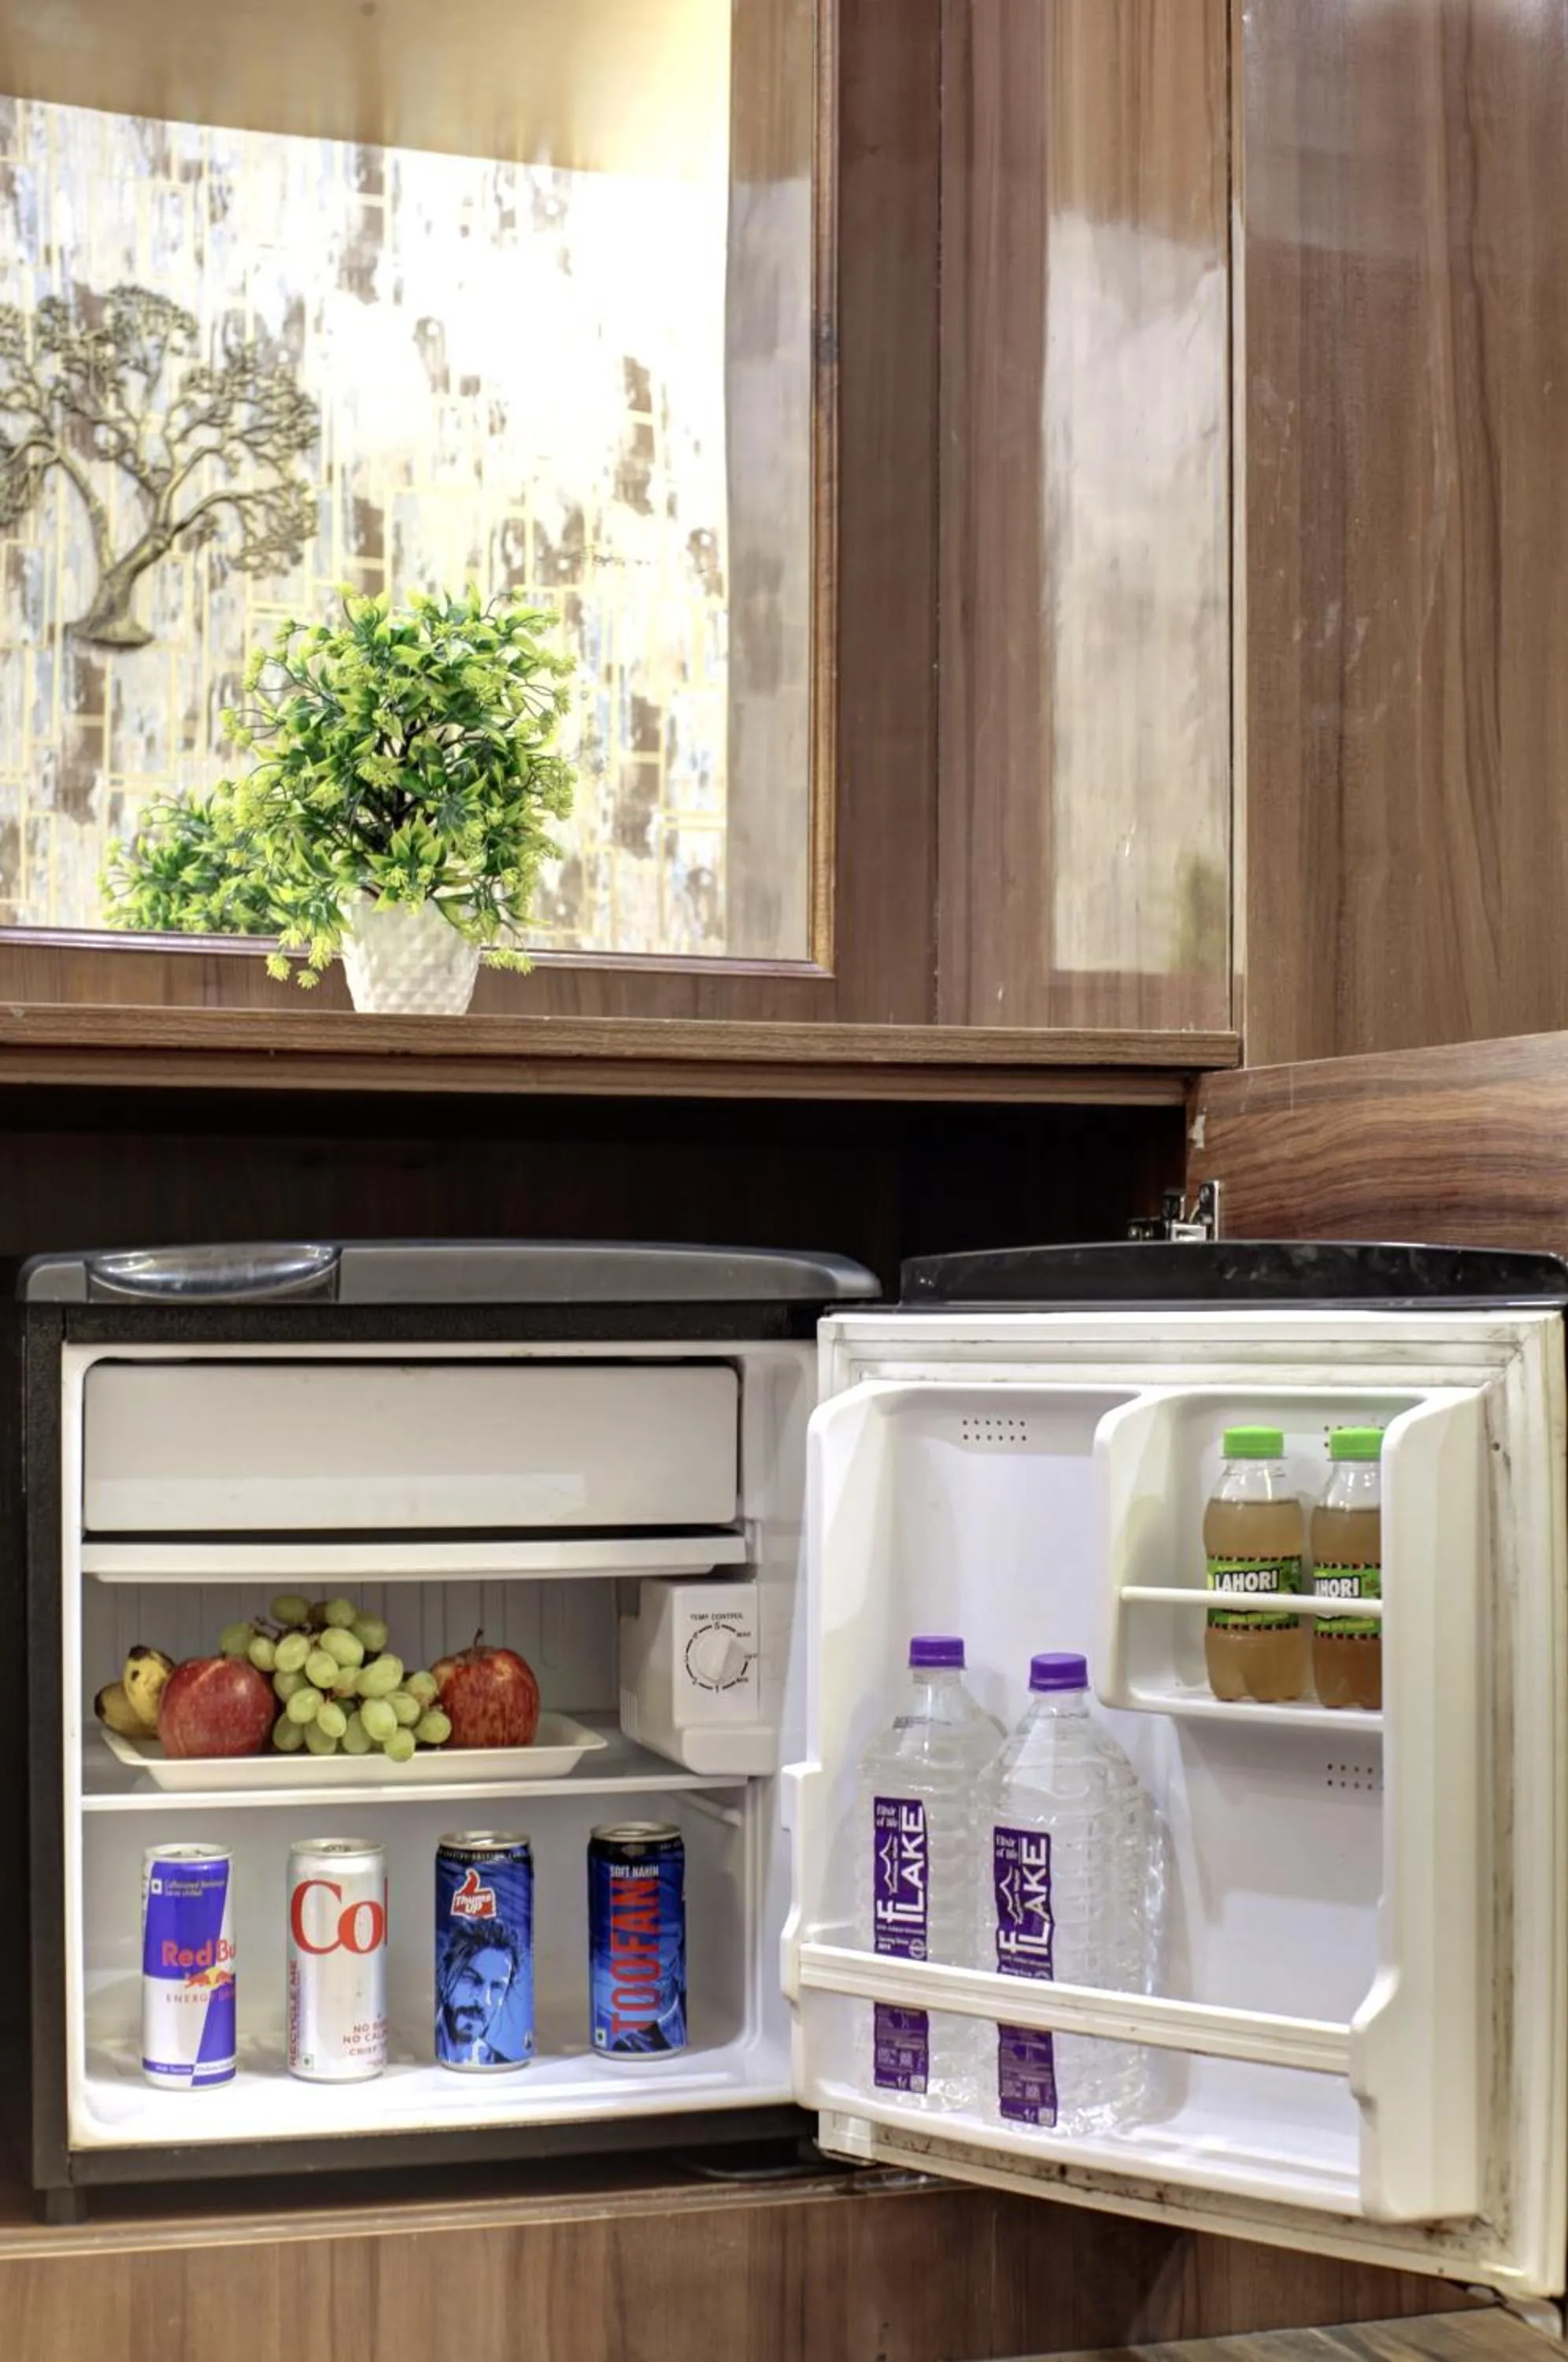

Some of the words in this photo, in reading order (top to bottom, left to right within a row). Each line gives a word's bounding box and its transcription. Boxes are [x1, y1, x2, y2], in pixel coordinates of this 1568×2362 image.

[1215, 1570, 1278, 1592] LAHORI
[609, 1864, 630, 1878] SOFT
[290, 1878, 388, 1954] Co
[161, 1939, 213, 1967] Red
[610, 1879, 662, 2034] TOOFAN
